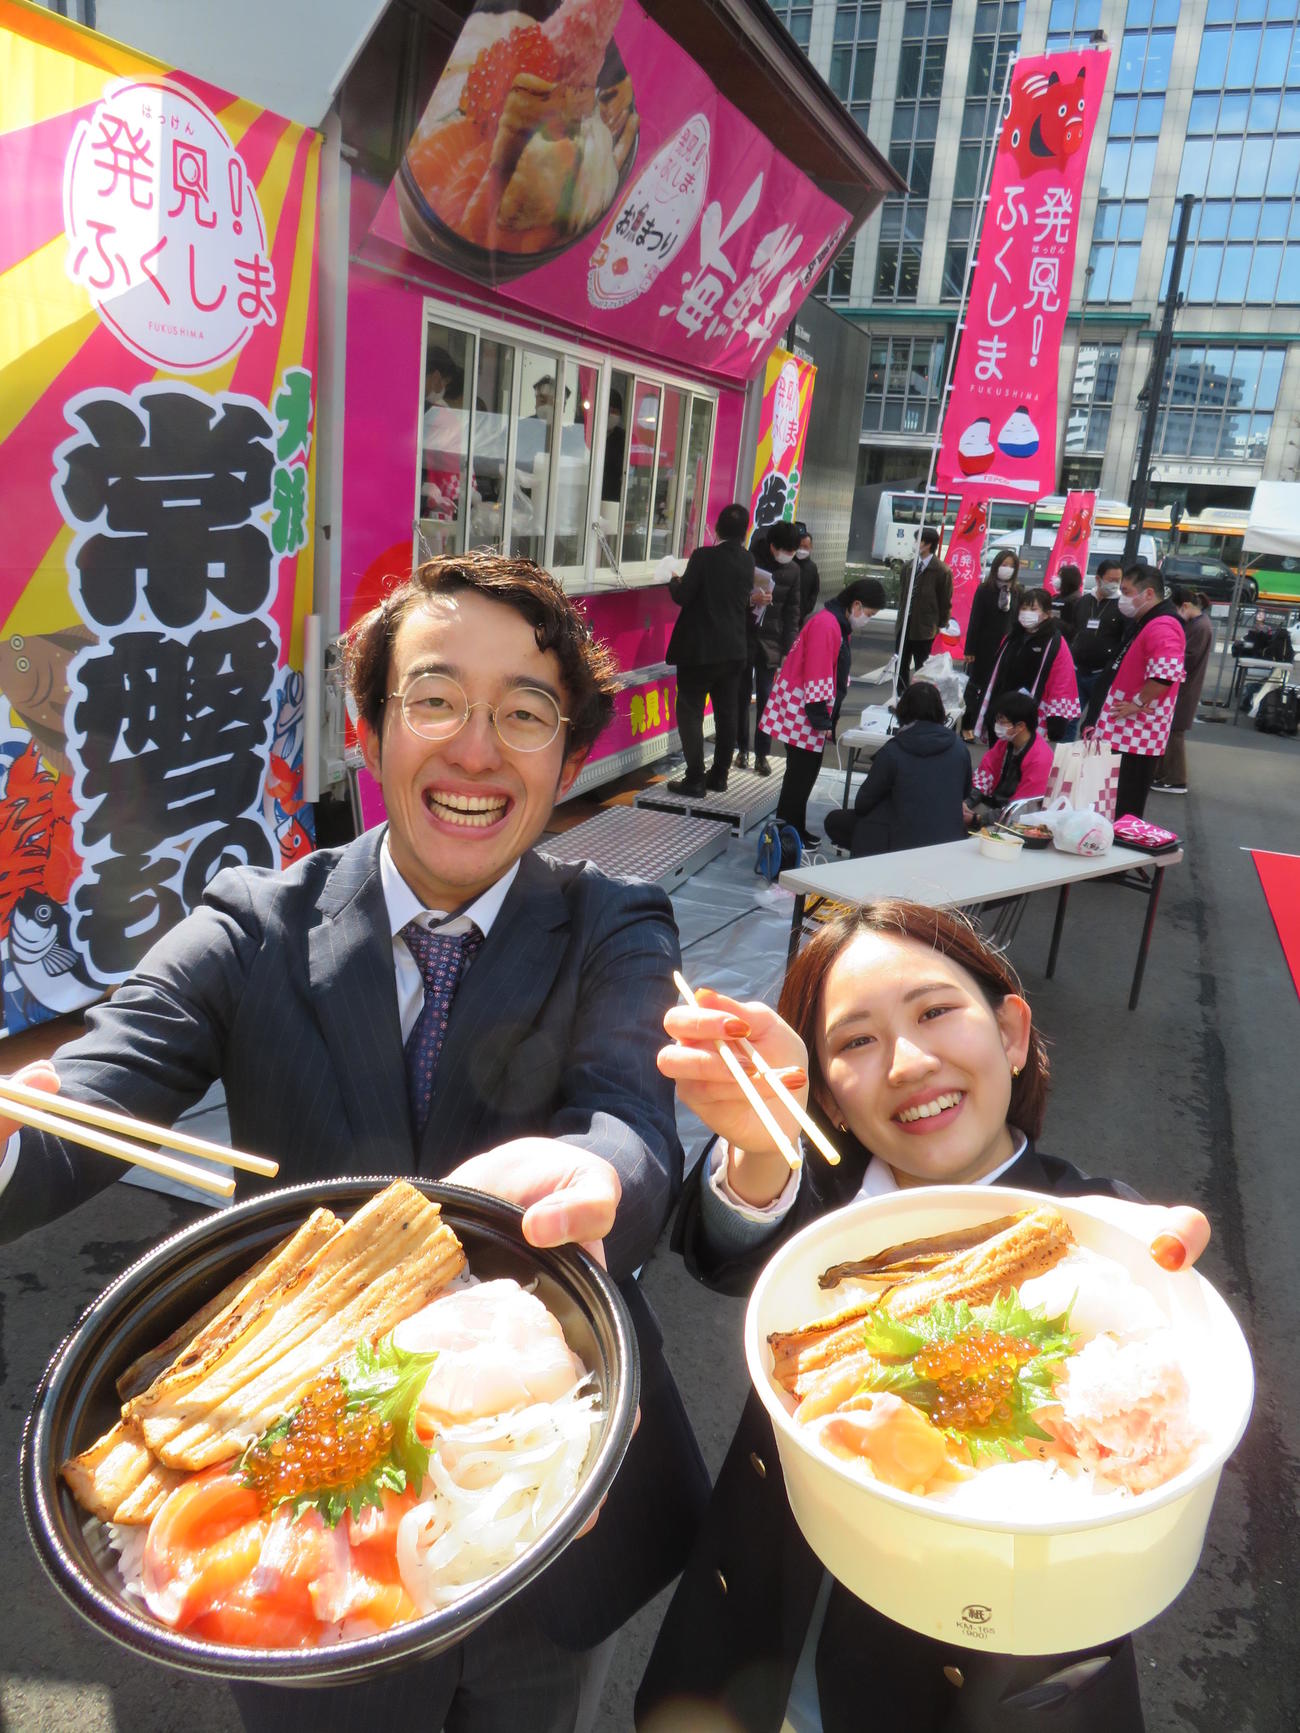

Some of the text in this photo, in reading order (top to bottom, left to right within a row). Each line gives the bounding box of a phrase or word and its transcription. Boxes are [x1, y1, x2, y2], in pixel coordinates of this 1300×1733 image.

[141, 103, 194, 136] はっけん
[91, 112, 243, 236] 発見!
[73, 219, 273, 320] ふくしま
[974, 186, 1029, 381] ふくしま
[1023, 187, 1073, 368] 発見!
[148, 321, 204, 340] FUKUSHIMA
[969, 384, 1040, 401] FUKUSHIMA
